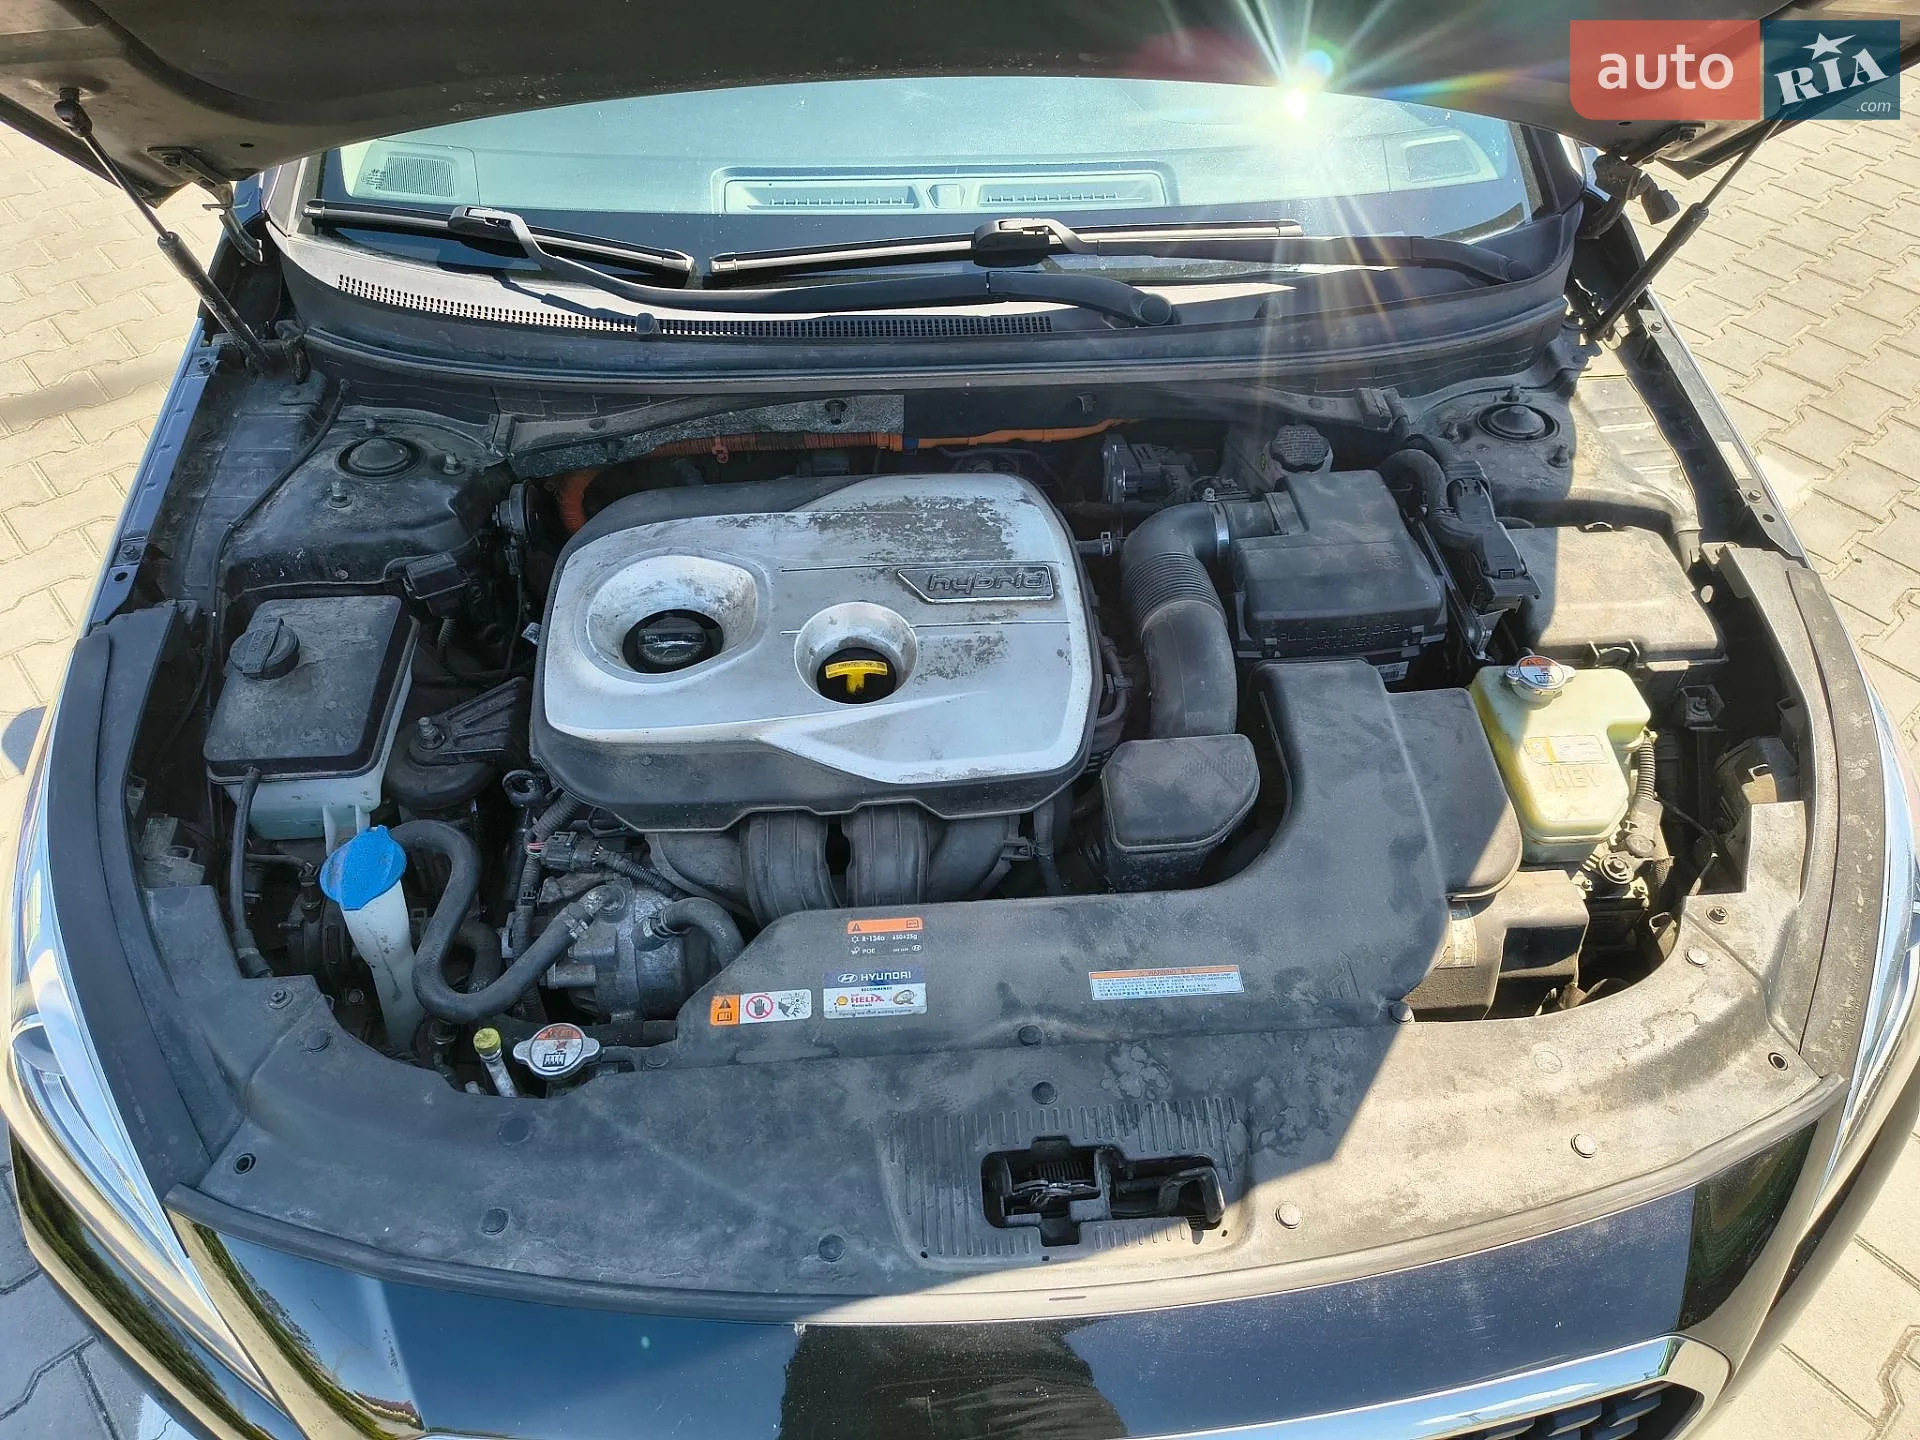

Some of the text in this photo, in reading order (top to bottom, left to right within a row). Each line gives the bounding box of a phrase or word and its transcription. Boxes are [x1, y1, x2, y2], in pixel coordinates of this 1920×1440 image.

[928, 569, 1046, 594] hybrid
[860, 971, 912, 982] HYUNDAI
[851, 995, 885, 1004] HELIX
